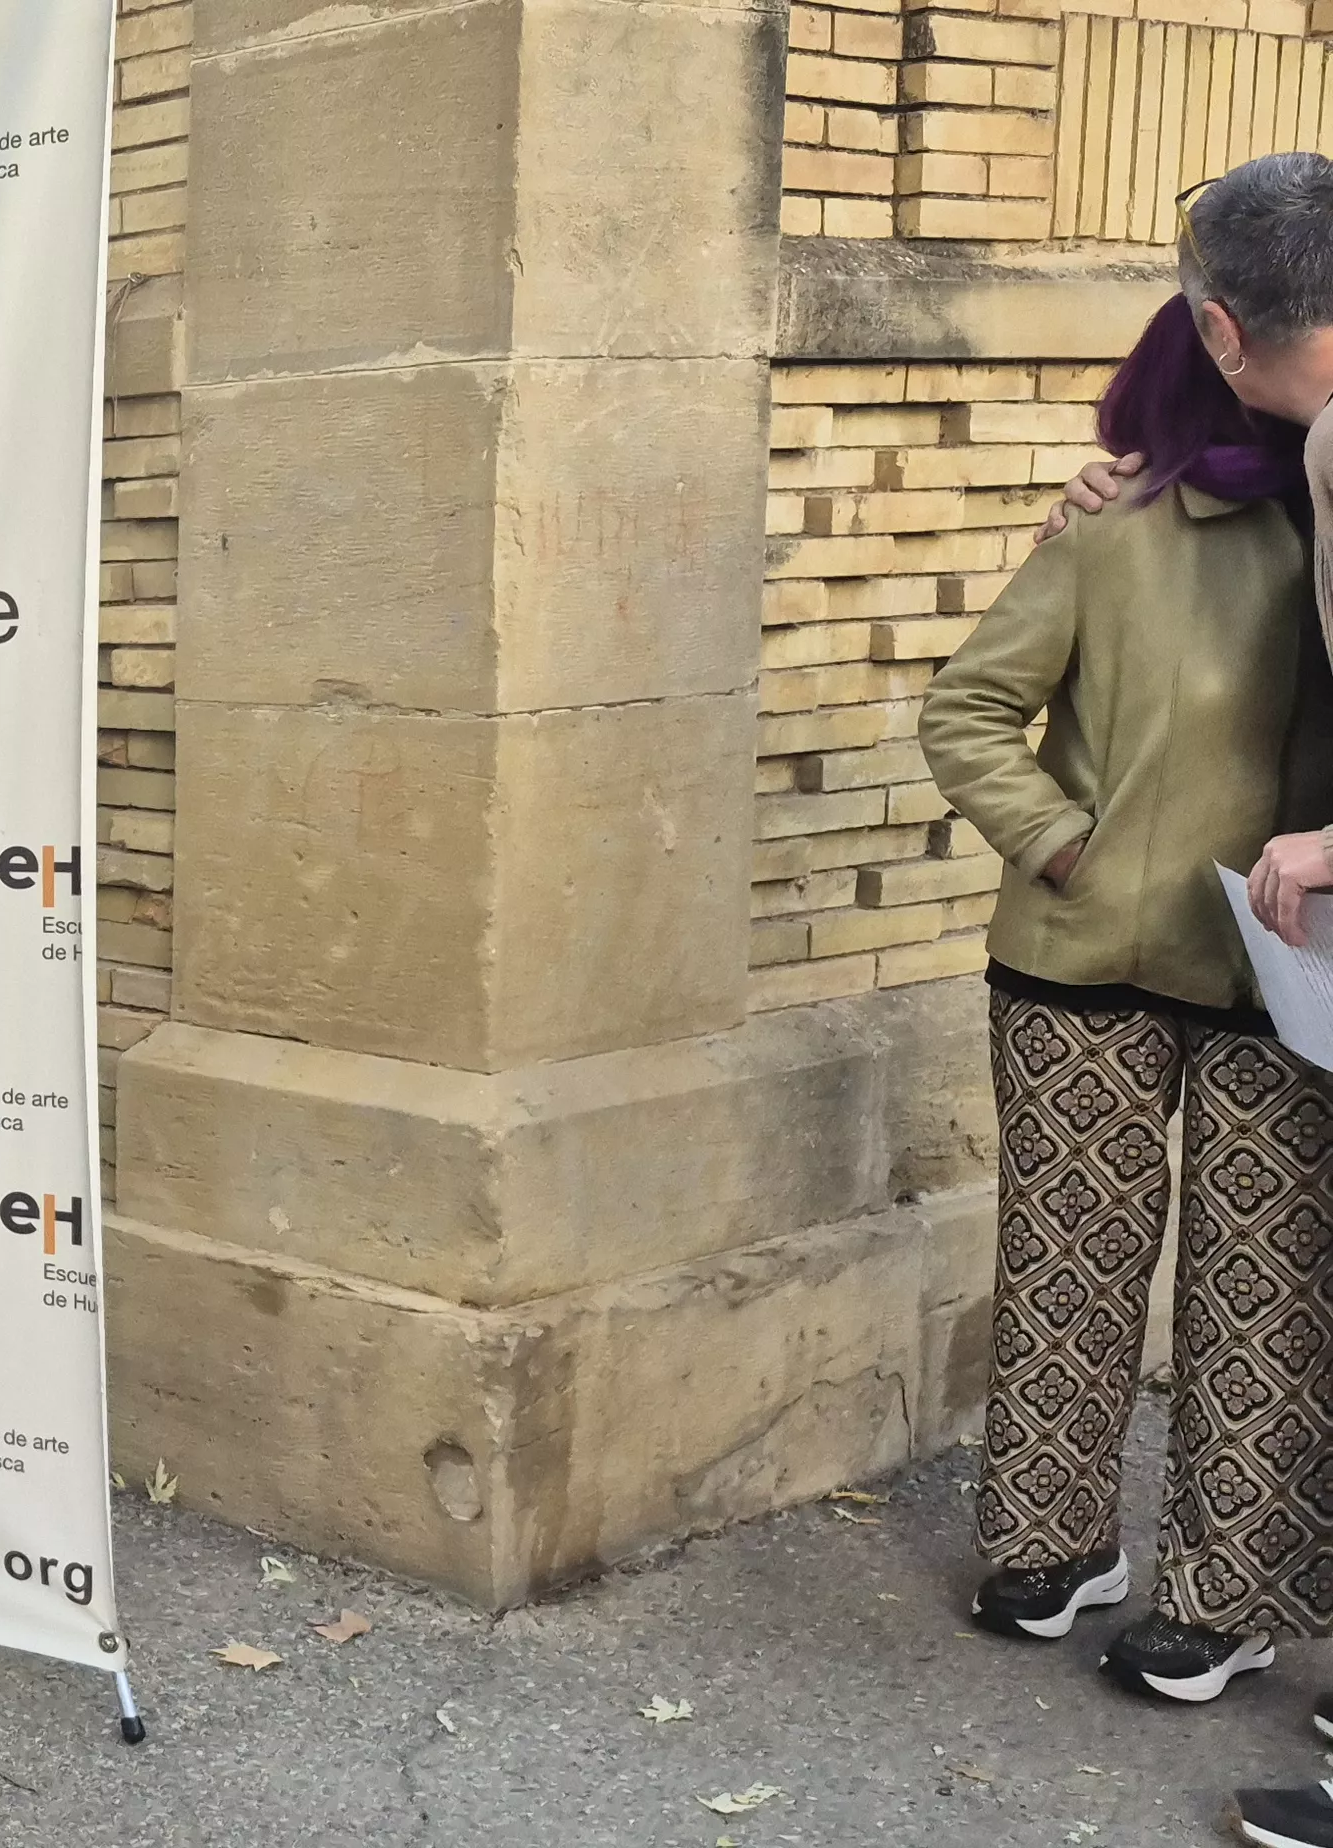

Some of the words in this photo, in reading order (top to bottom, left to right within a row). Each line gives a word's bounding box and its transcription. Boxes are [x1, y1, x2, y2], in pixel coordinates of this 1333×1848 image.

[0, 131, 22, 150] de
[29, 127, 69, 146] arte
[42, 943, 66, 960] de
[2, 1088, 25, 1105] de
[32, 1092, 68, 1109] arte
[43, 1263, 97, 1288] Escue
[43, 1290, 67, 1308] de
[4, 1429, 27, 1447] de
[33, 1437, 69, 1454] arte
